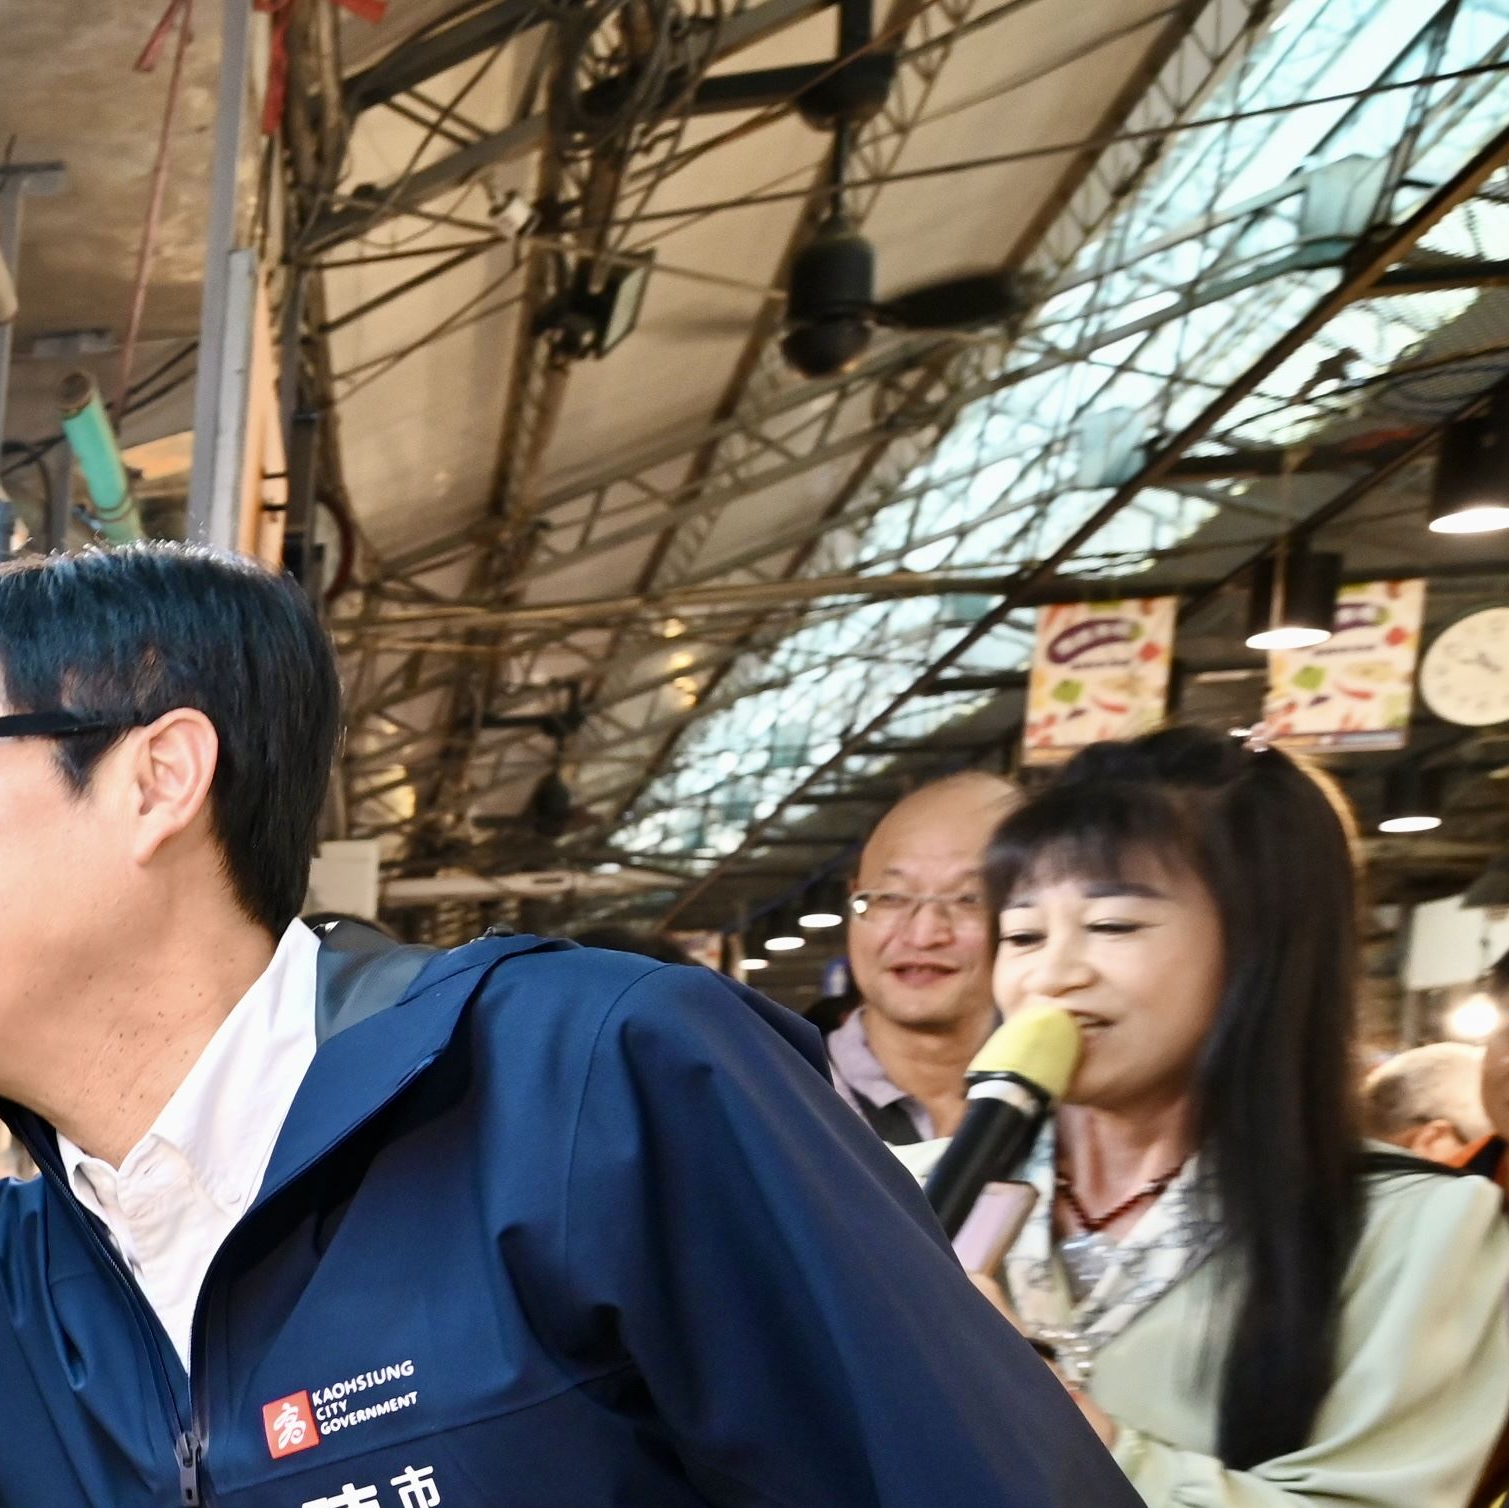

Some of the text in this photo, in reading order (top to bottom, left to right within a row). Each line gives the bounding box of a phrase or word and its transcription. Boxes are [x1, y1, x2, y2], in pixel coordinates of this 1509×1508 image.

[311, 1359, 415, 1408] KAOHSIUNG
[315, 1398, 348, 1422] CITY
[319, 1390, 419, 1436] GOVERNMENT
